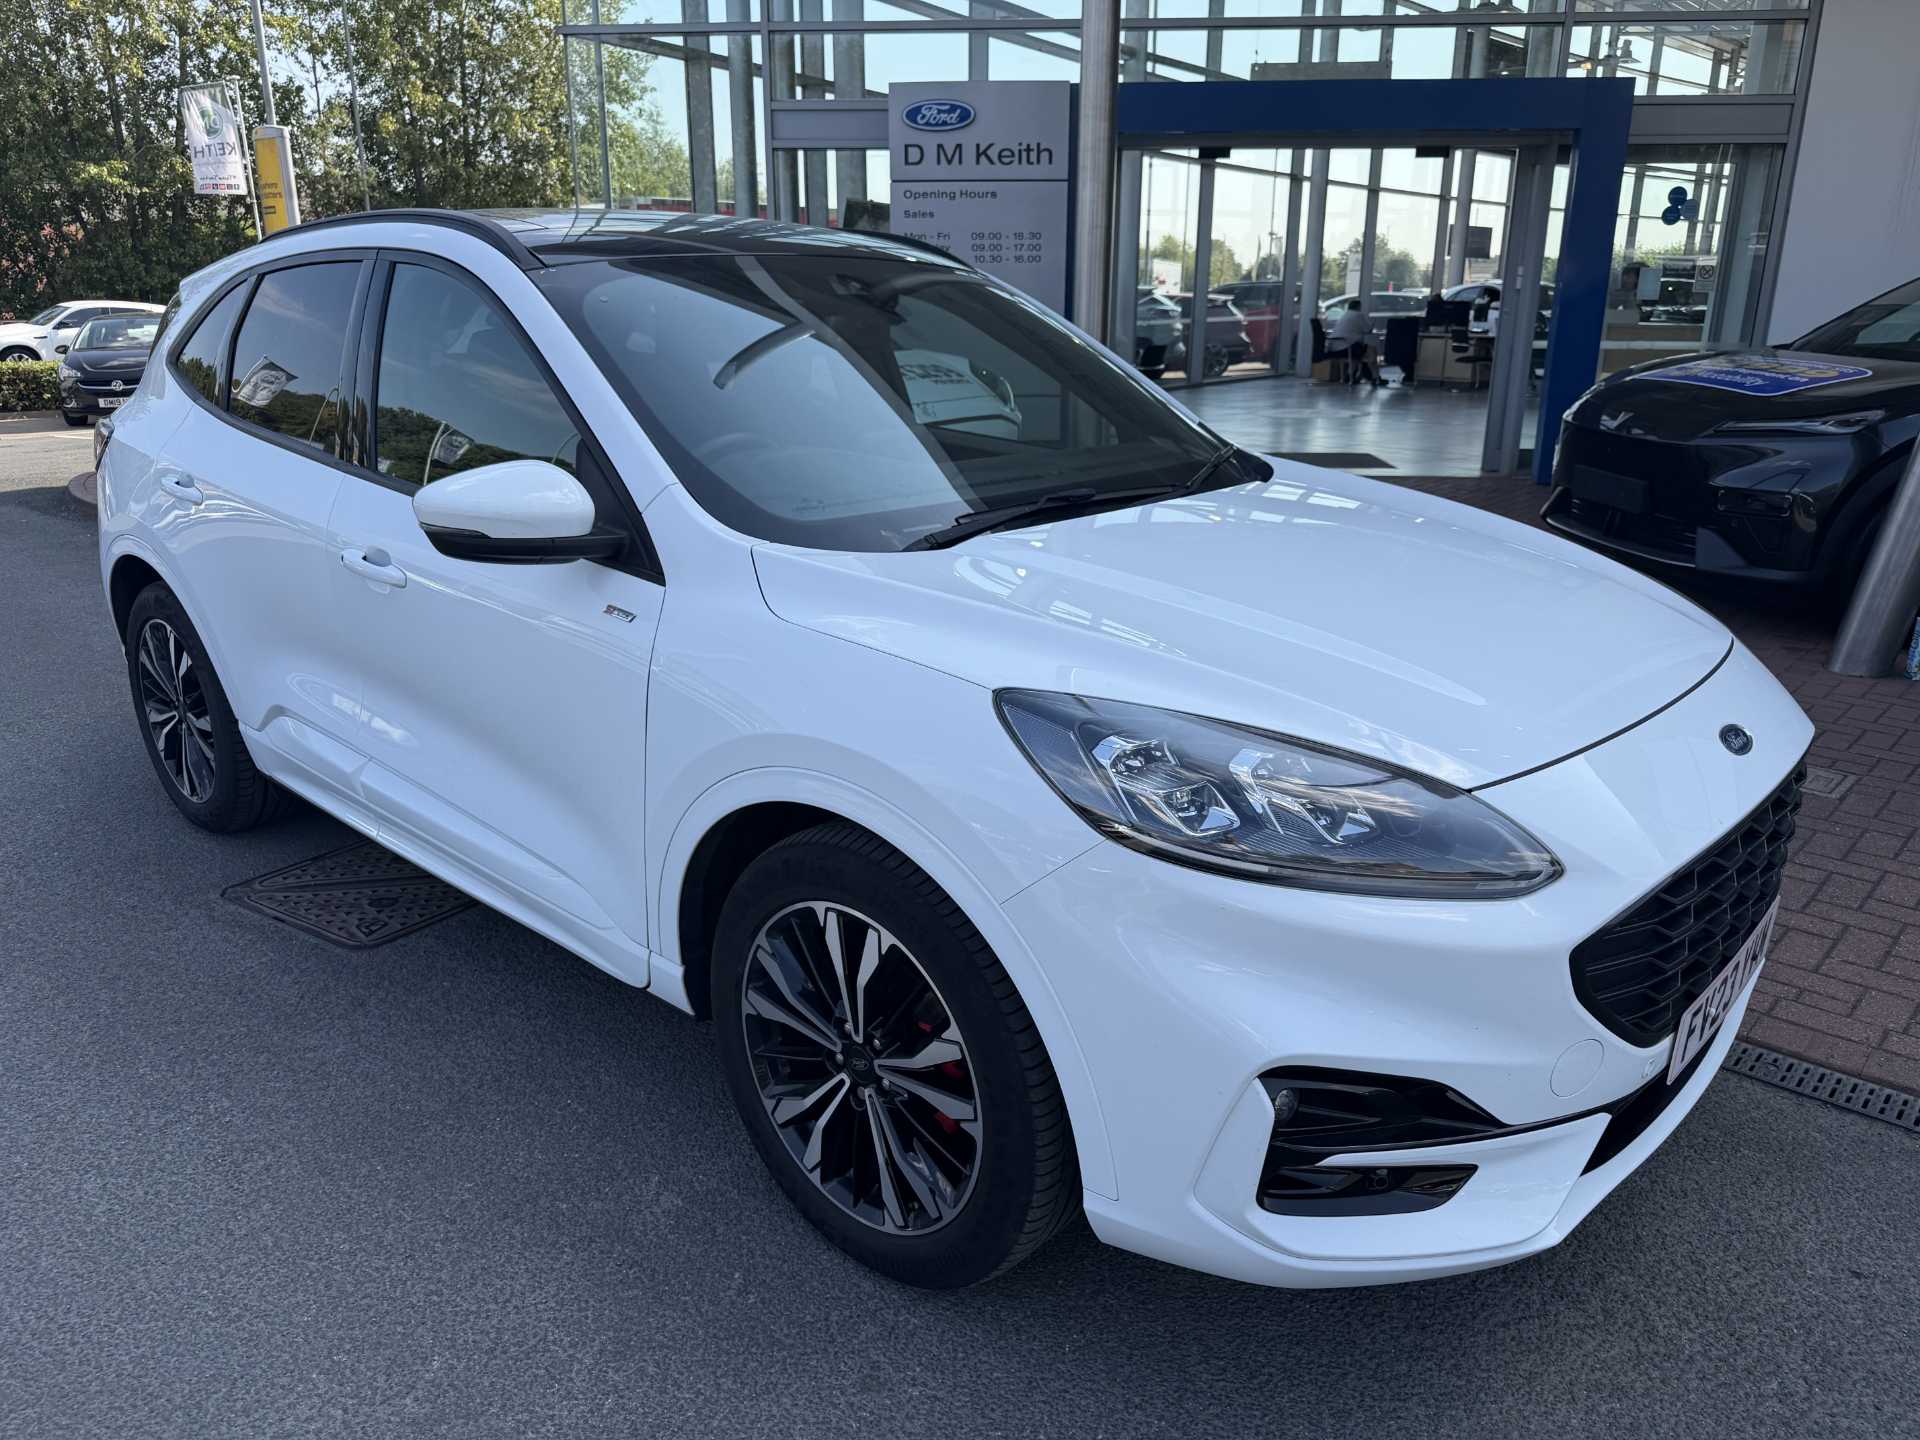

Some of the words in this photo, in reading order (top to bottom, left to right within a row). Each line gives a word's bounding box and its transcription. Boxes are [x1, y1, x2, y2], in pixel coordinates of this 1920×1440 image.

[916, 104, 961, 125] Ford
[904, 143, 925, 166] D
[936, 143, 963, 166] M
[975, 142, 1053, 166] Keith
[903, 190, 956, 200] Opening
[960, 189, 997, 199] Hours
[903, 209, 935, 219] Sales
[937, 232, 951, 240] Fri
[971, 232, 1001, 240] 09.00
[971, 243, 1002, 252] 09.00
[1013, 243, 1042, 252] 17.00
[974, 255, 1002, 263] 10.30
